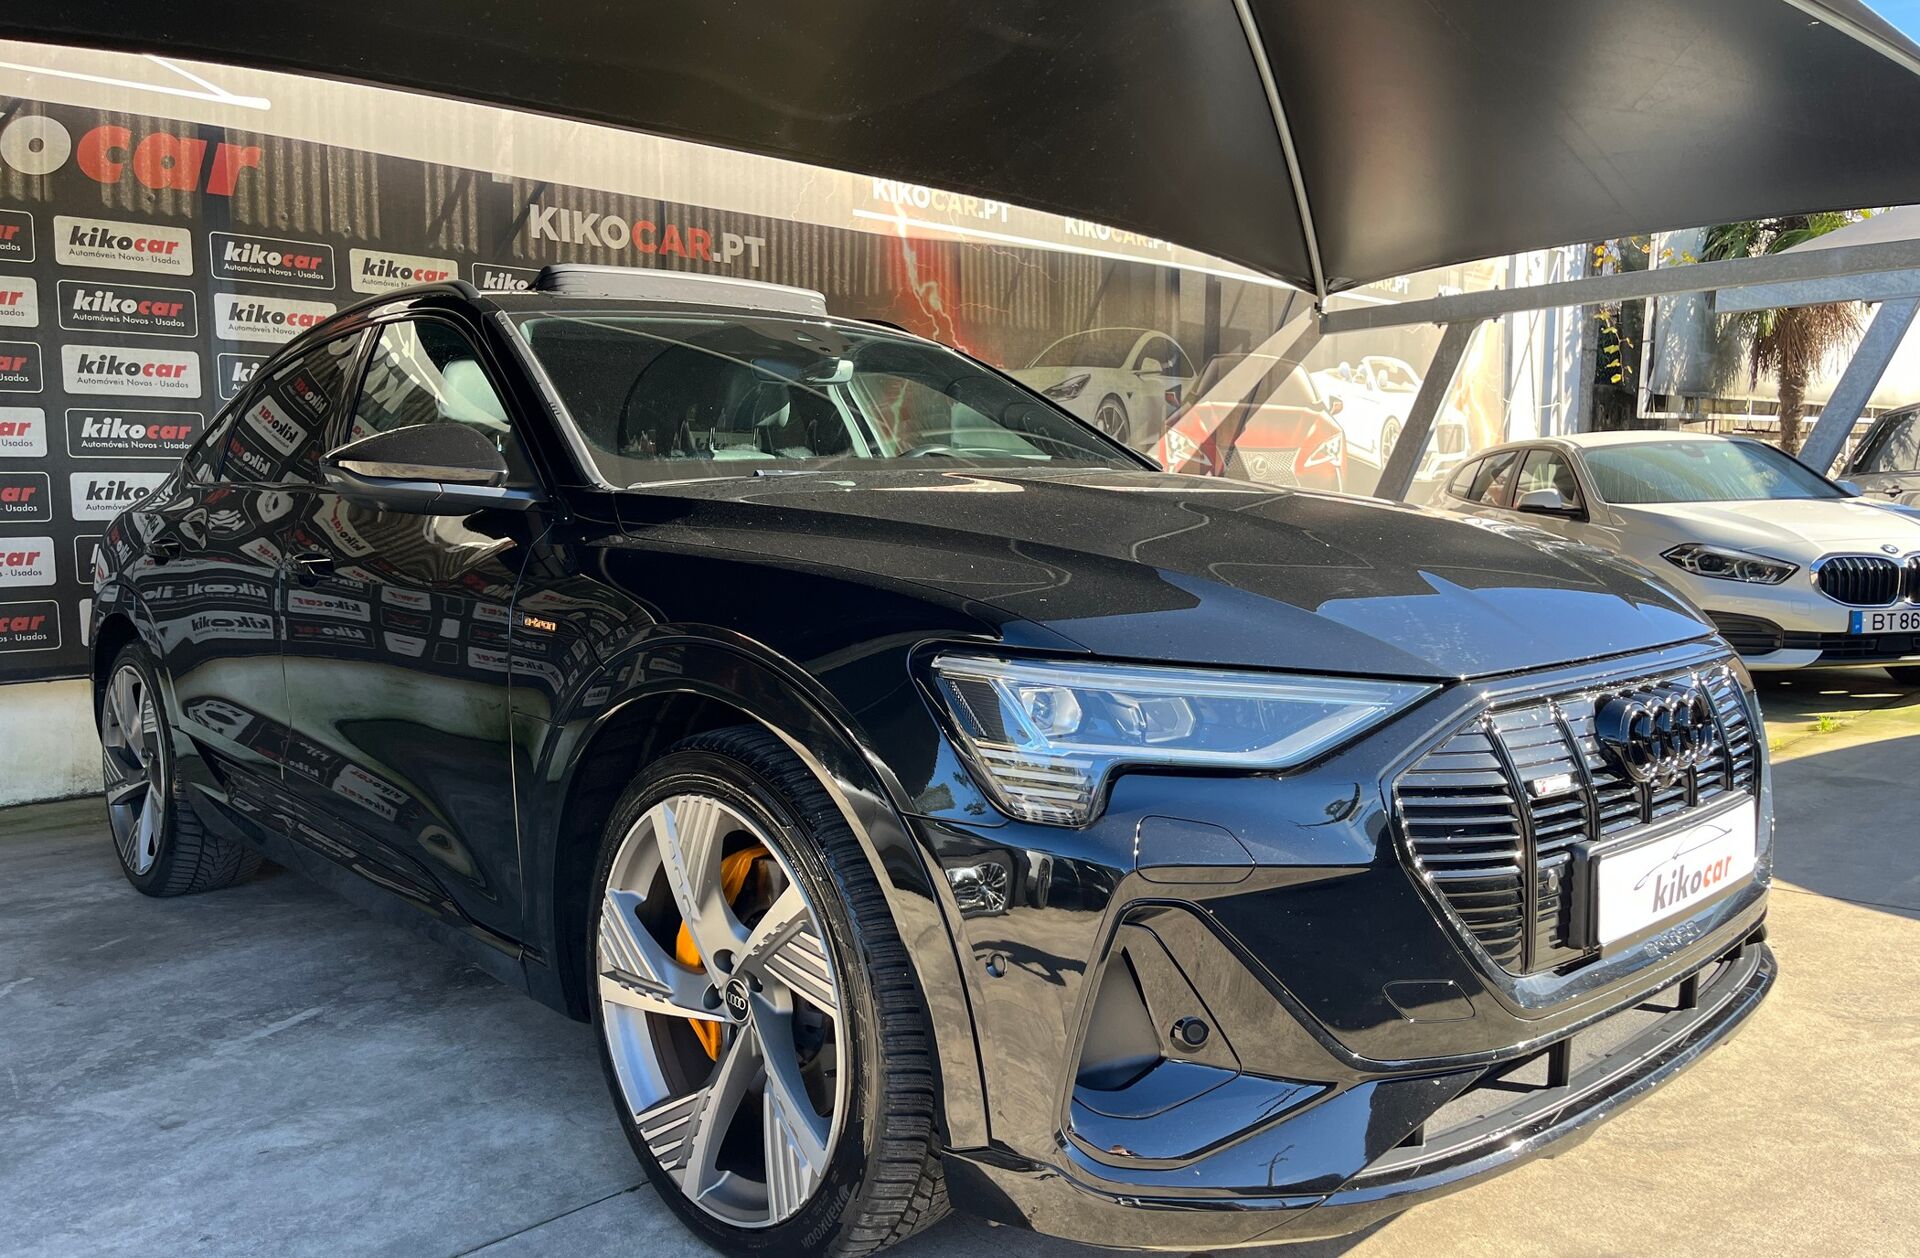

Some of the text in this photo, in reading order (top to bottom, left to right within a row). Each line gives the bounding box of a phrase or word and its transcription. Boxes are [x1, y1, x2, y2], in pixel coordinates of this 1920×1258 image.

[0, 113, 262, 197] ocar
[872, 178, 1012, 223] KIKOCAR.PT
[69, 225, 179, 255] kikocar
[529, 203, 766, 268] KIKOCAR.PT
[69, 248, 116, 260] Automóveis
[118, 253, 144, 262] Novos
[151, 255, 181, 265] Usados
[223, 241, 322, 270] kikocar
[223, 263, 267, 274] Automóveis
[268, 267, 292, 277] Novos
[297, 270, 324, 280] Usados
[362, 257, 449, 282] kikocar
[483, 271, 529, 290] kiko
[73, 289, 184, 317] kikocar
[73, 312, 120, 323] Automóveis
[122, 315, 149, 325] Novos
[155, 318, 185, 327] Usados
[228, 323, 271, 334] Automóveis
[273, 327, 296, 335] Novos
[77, 353, 187, 378] kikocar
[77, 376, 124, 386] Automóveis
[126, 379, 153, 387] Novos
[159, 380, 189, 388] Usados
[81, 417, 192, 440] kikocar
[1, 438, 34, 448] Usados
[81, 439, 129, 449] Automóveis
[131, 441, 157, 449] Novos
[5, 503, 38, 512] Usados
[10, 568, 43, 577] Usados
[1872, 613, 1897, 631] BT
[1899, 612, 1920, 630] 86
[15, 632, 47, 642] Usados
[1652, 856, 1732, 913] kikocar
